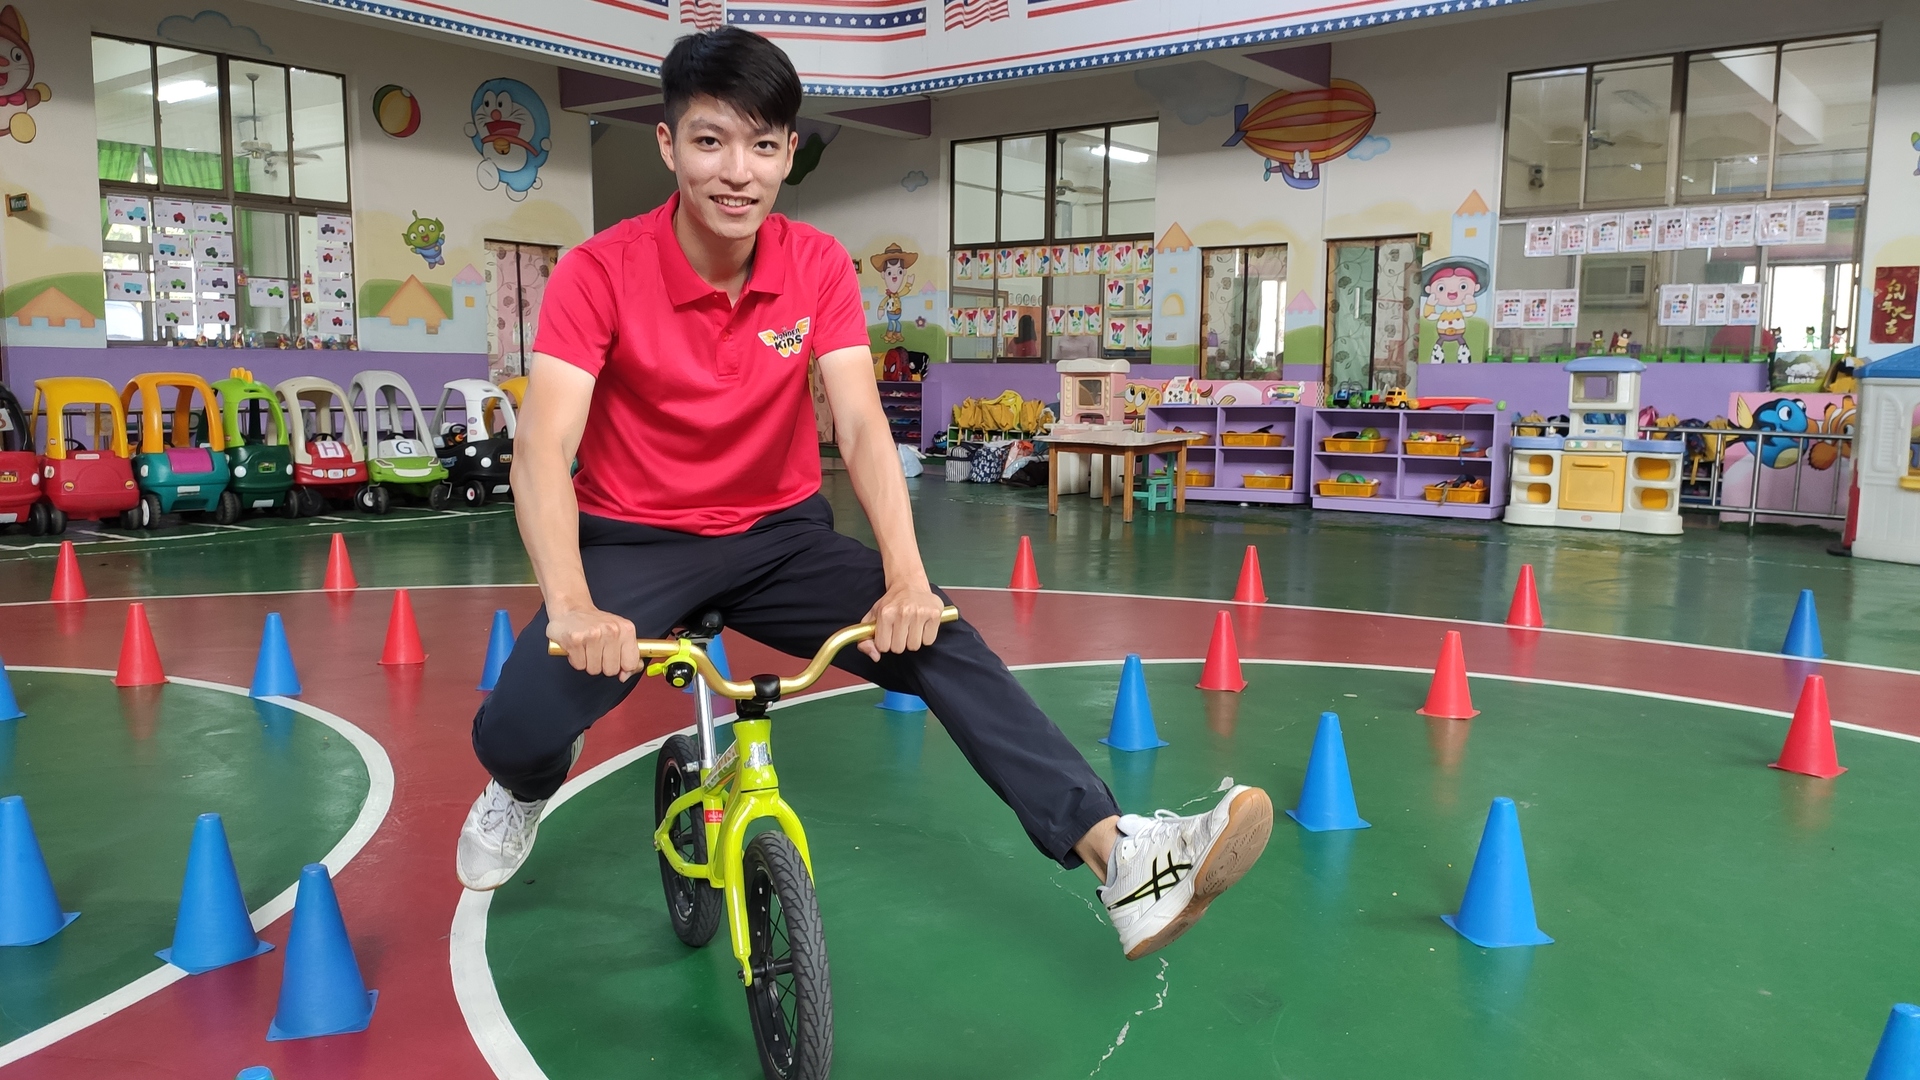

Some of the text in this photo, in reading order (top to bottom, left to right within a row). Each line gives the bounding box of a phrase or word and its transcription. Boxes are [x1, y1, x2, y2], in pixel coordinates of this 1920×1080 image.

[772, 328, 800, 341] WONDER
[1787, 376, 1816, 384] Roots
[320, 442, 341, 456] H
[395, 441, 413, 455] G
